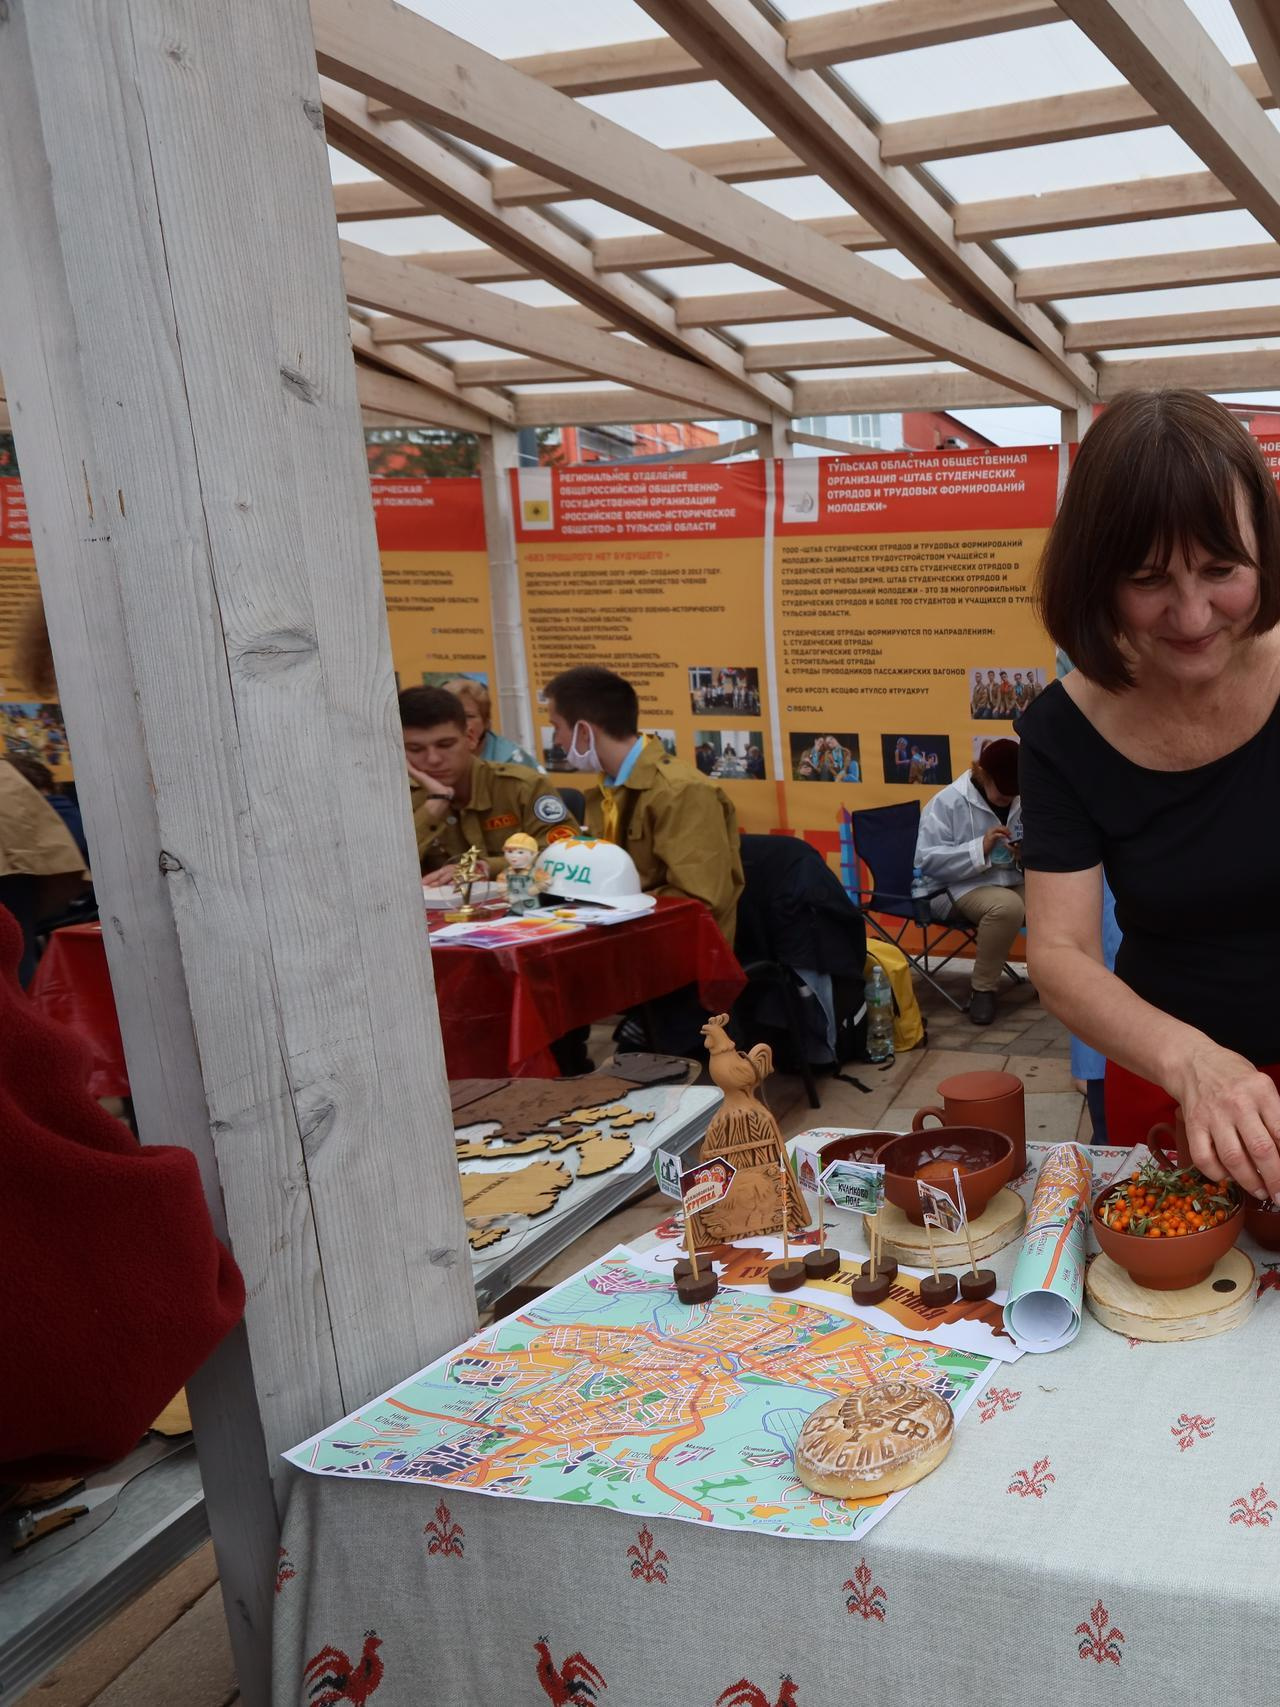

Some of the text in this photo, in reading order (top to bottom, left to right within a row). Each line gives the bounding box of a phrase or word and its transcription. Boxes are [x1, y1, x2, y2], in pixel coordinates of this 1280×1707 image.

[829, 454, 1027, 472] ТУЛЬСКАЯ ОБЛАСТНАЯ ОБЩЕСТВЕННАЯ
[560, 471, 687, 482] РЕГИОНАЛЬНОЕ ОТДЕЛЕНИЕ
[828, 469, 1015, 485] ОРГАНИЗАЦИЯ «ШТАБ СТУДЕНЧЕСКИХ
[560, 484, 722, 495] ОБЩЕРОССИЙСКОЙ ОБЩЕСТВЕННО-
[828, 482, 1025, 499] ОТРЯДОВ И ТРУДОВЫХ ФОРМИРОВАНИЙ
[561, 496, 716, 509] ГОСУДАРСТВЕННОЙ ОРГАНИЗАЦИИ
[828, 502, 887, 513] МОЛОДЕЖИ»
[625, 509, 735, 520] ВОЕННО-ИСТОРИЧЕСКОЕ
[617, 524, 623, 533] В
[626, 523, 672, 533] ТУЛЬСКОЙ
[674, 523, 716, 532] ОБЛАСТИ
[544, 859, 592, 884] ТРУД
[838, 1183, 868, 1199] КУЛИКОВО
[845, 1196, 860, 1207] ПОЛЕ
[738, 1266, 768, 1278] ТУ
